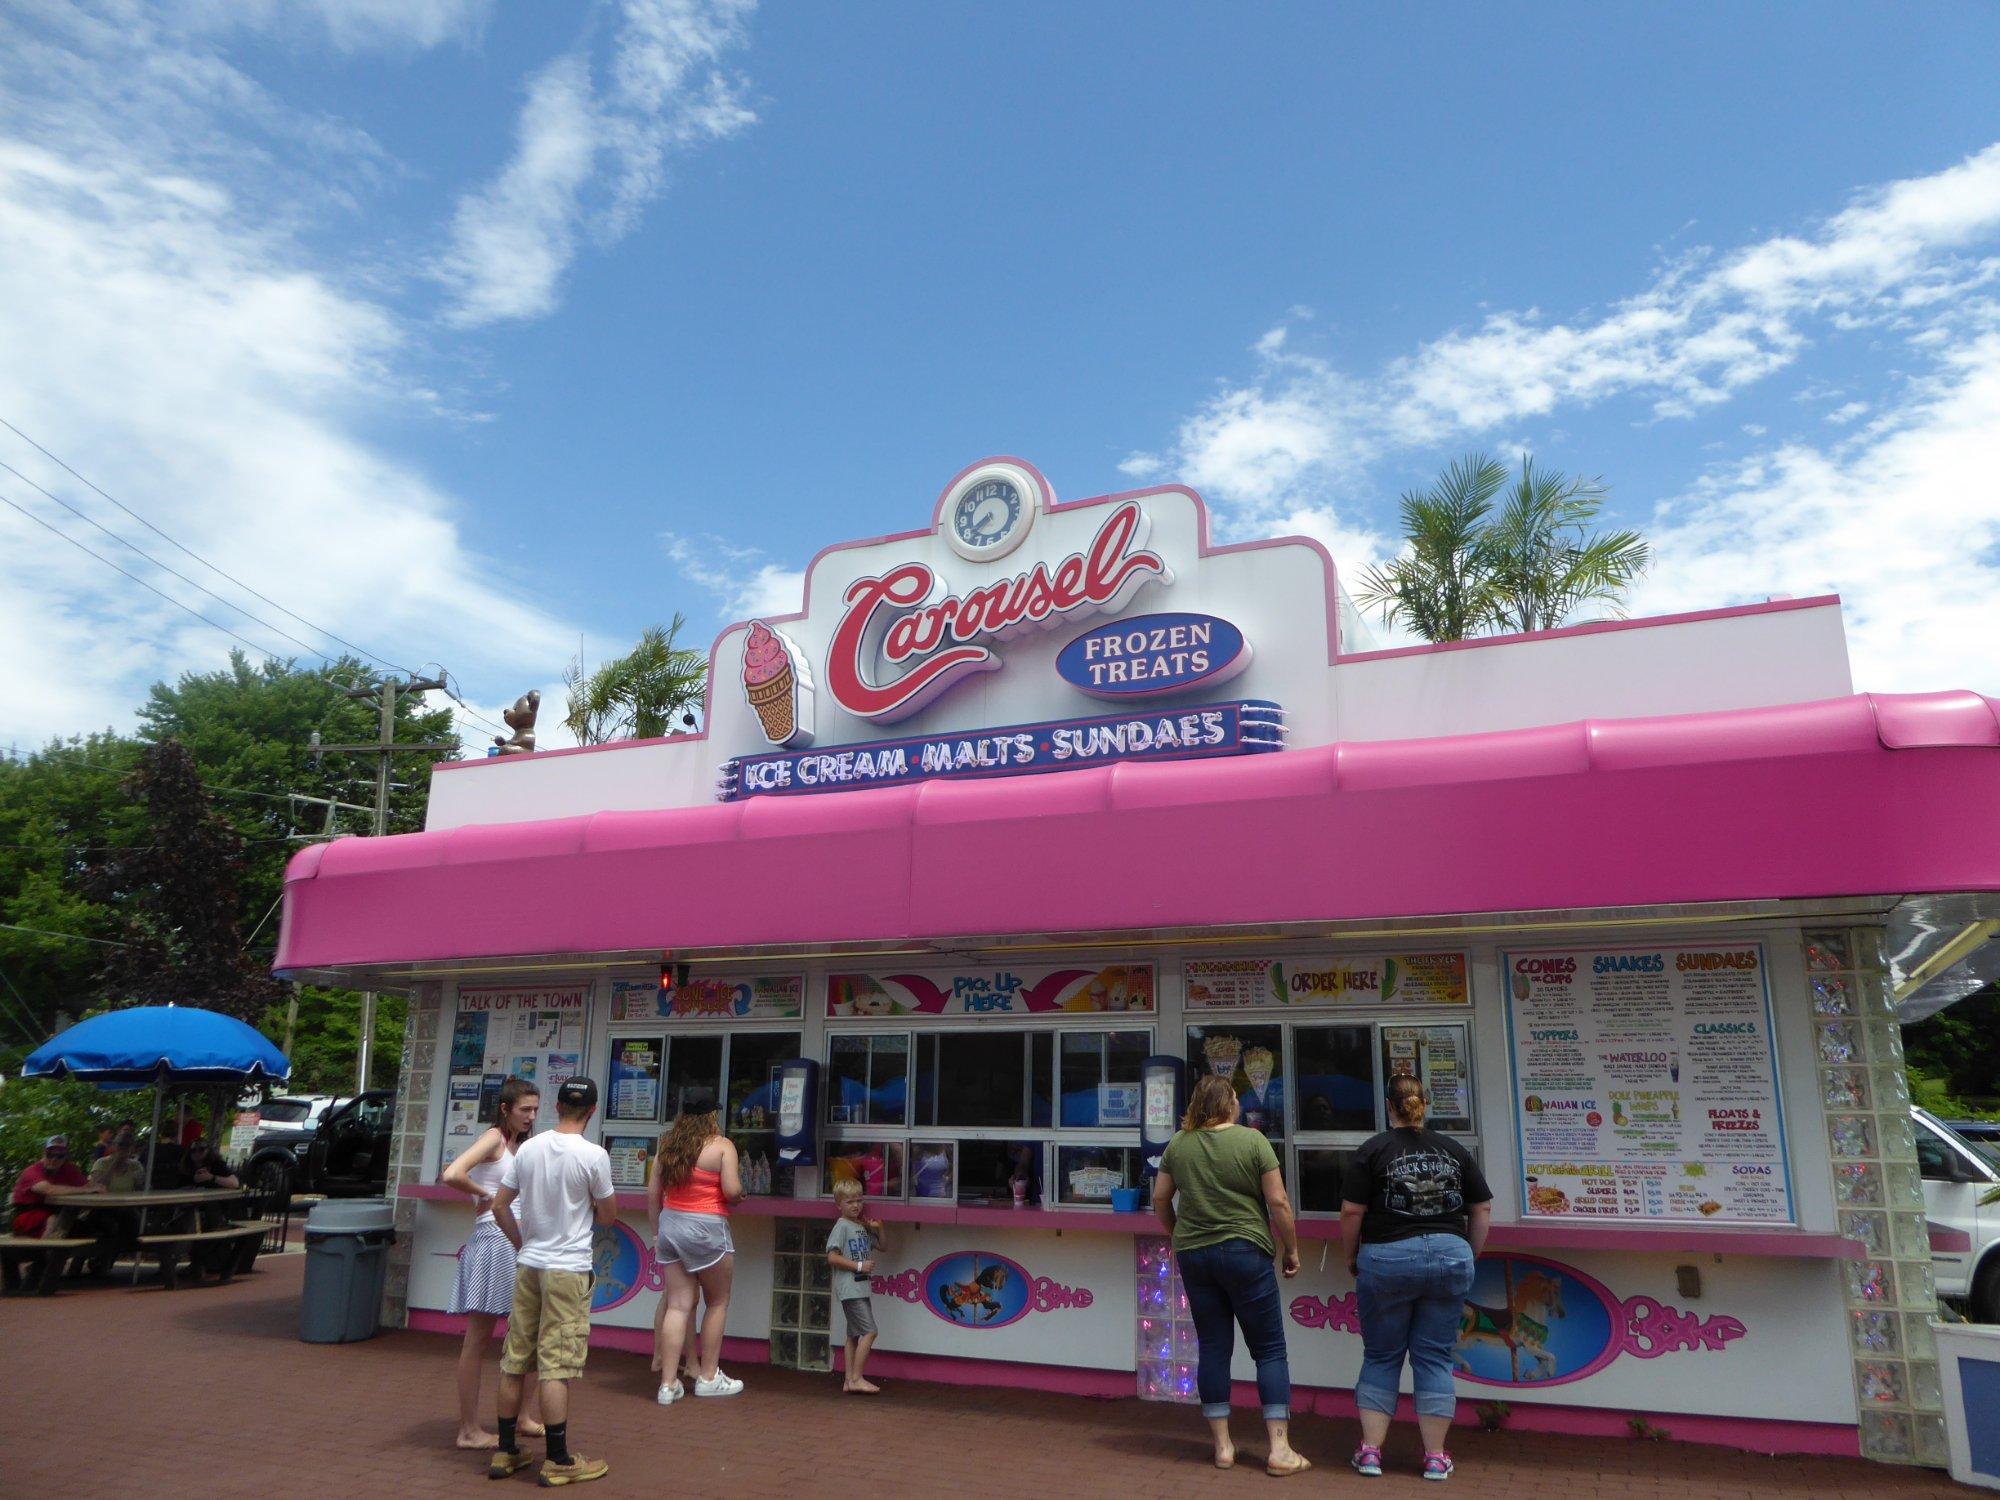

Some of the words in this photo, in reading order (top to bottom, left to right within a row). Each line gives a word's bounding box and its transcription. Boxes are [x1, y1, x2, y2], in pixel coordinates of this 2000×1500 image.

[986, 485, 997, 496] 12
[965, 501, 975, 513] 10
[960, 516, 967, 527] 9
[964, 529, 971, 539] 8
[974, 536, 982, 546] 7
[825, 501, 1164, 717] Carousel
[1085, 623, 1211, 660] FROZEN
[1089, 650, 1210, 685] TREATS
[745, 760, 792, 791] ICE
[797, 749, 907, 785] CREAM
[920, 732, 1035, 774] MALTS
[1052, 711, 1226, 760] SUNDAES
[1515, 957, 1577, 974] CONES
[1592, 953, 1665, 974] SHAKES
[1676, 951, 1758, 971] SUNDAES
[995, 971, 1023, 994] UP
[1291, 972, 1338, 993] ORDER
[1343, 971, 1379, 991] HERE
[1543, 973, 1573, 984] CUPS
[462, 995, 491, 1010] TALK
[495, 994, 512, 1009] OF
[515, 994, 538, 1009] THE
[540, 992, 583, 1008] TOWN
[964, 993, 1013, 1012] HERE
[1694, 1022, 1756, 1035] CLASSICS
[1530, 1030, 1579, 1041] TOPPERS
[1609, 1052, 1667, 1063] WATERLOO
[1582, 1100, 1597, 1110] ICE
[1708, 1109, 1749, 1119] FLOATS
[1712, 1120, 1760, 1131] FREEZES
[1732, 1166, 1772, 1175] SODAS
[1586, 1187, 1618, 1195] SLIDERS
[1598, 1206, 1619, 1214] STRIPS
